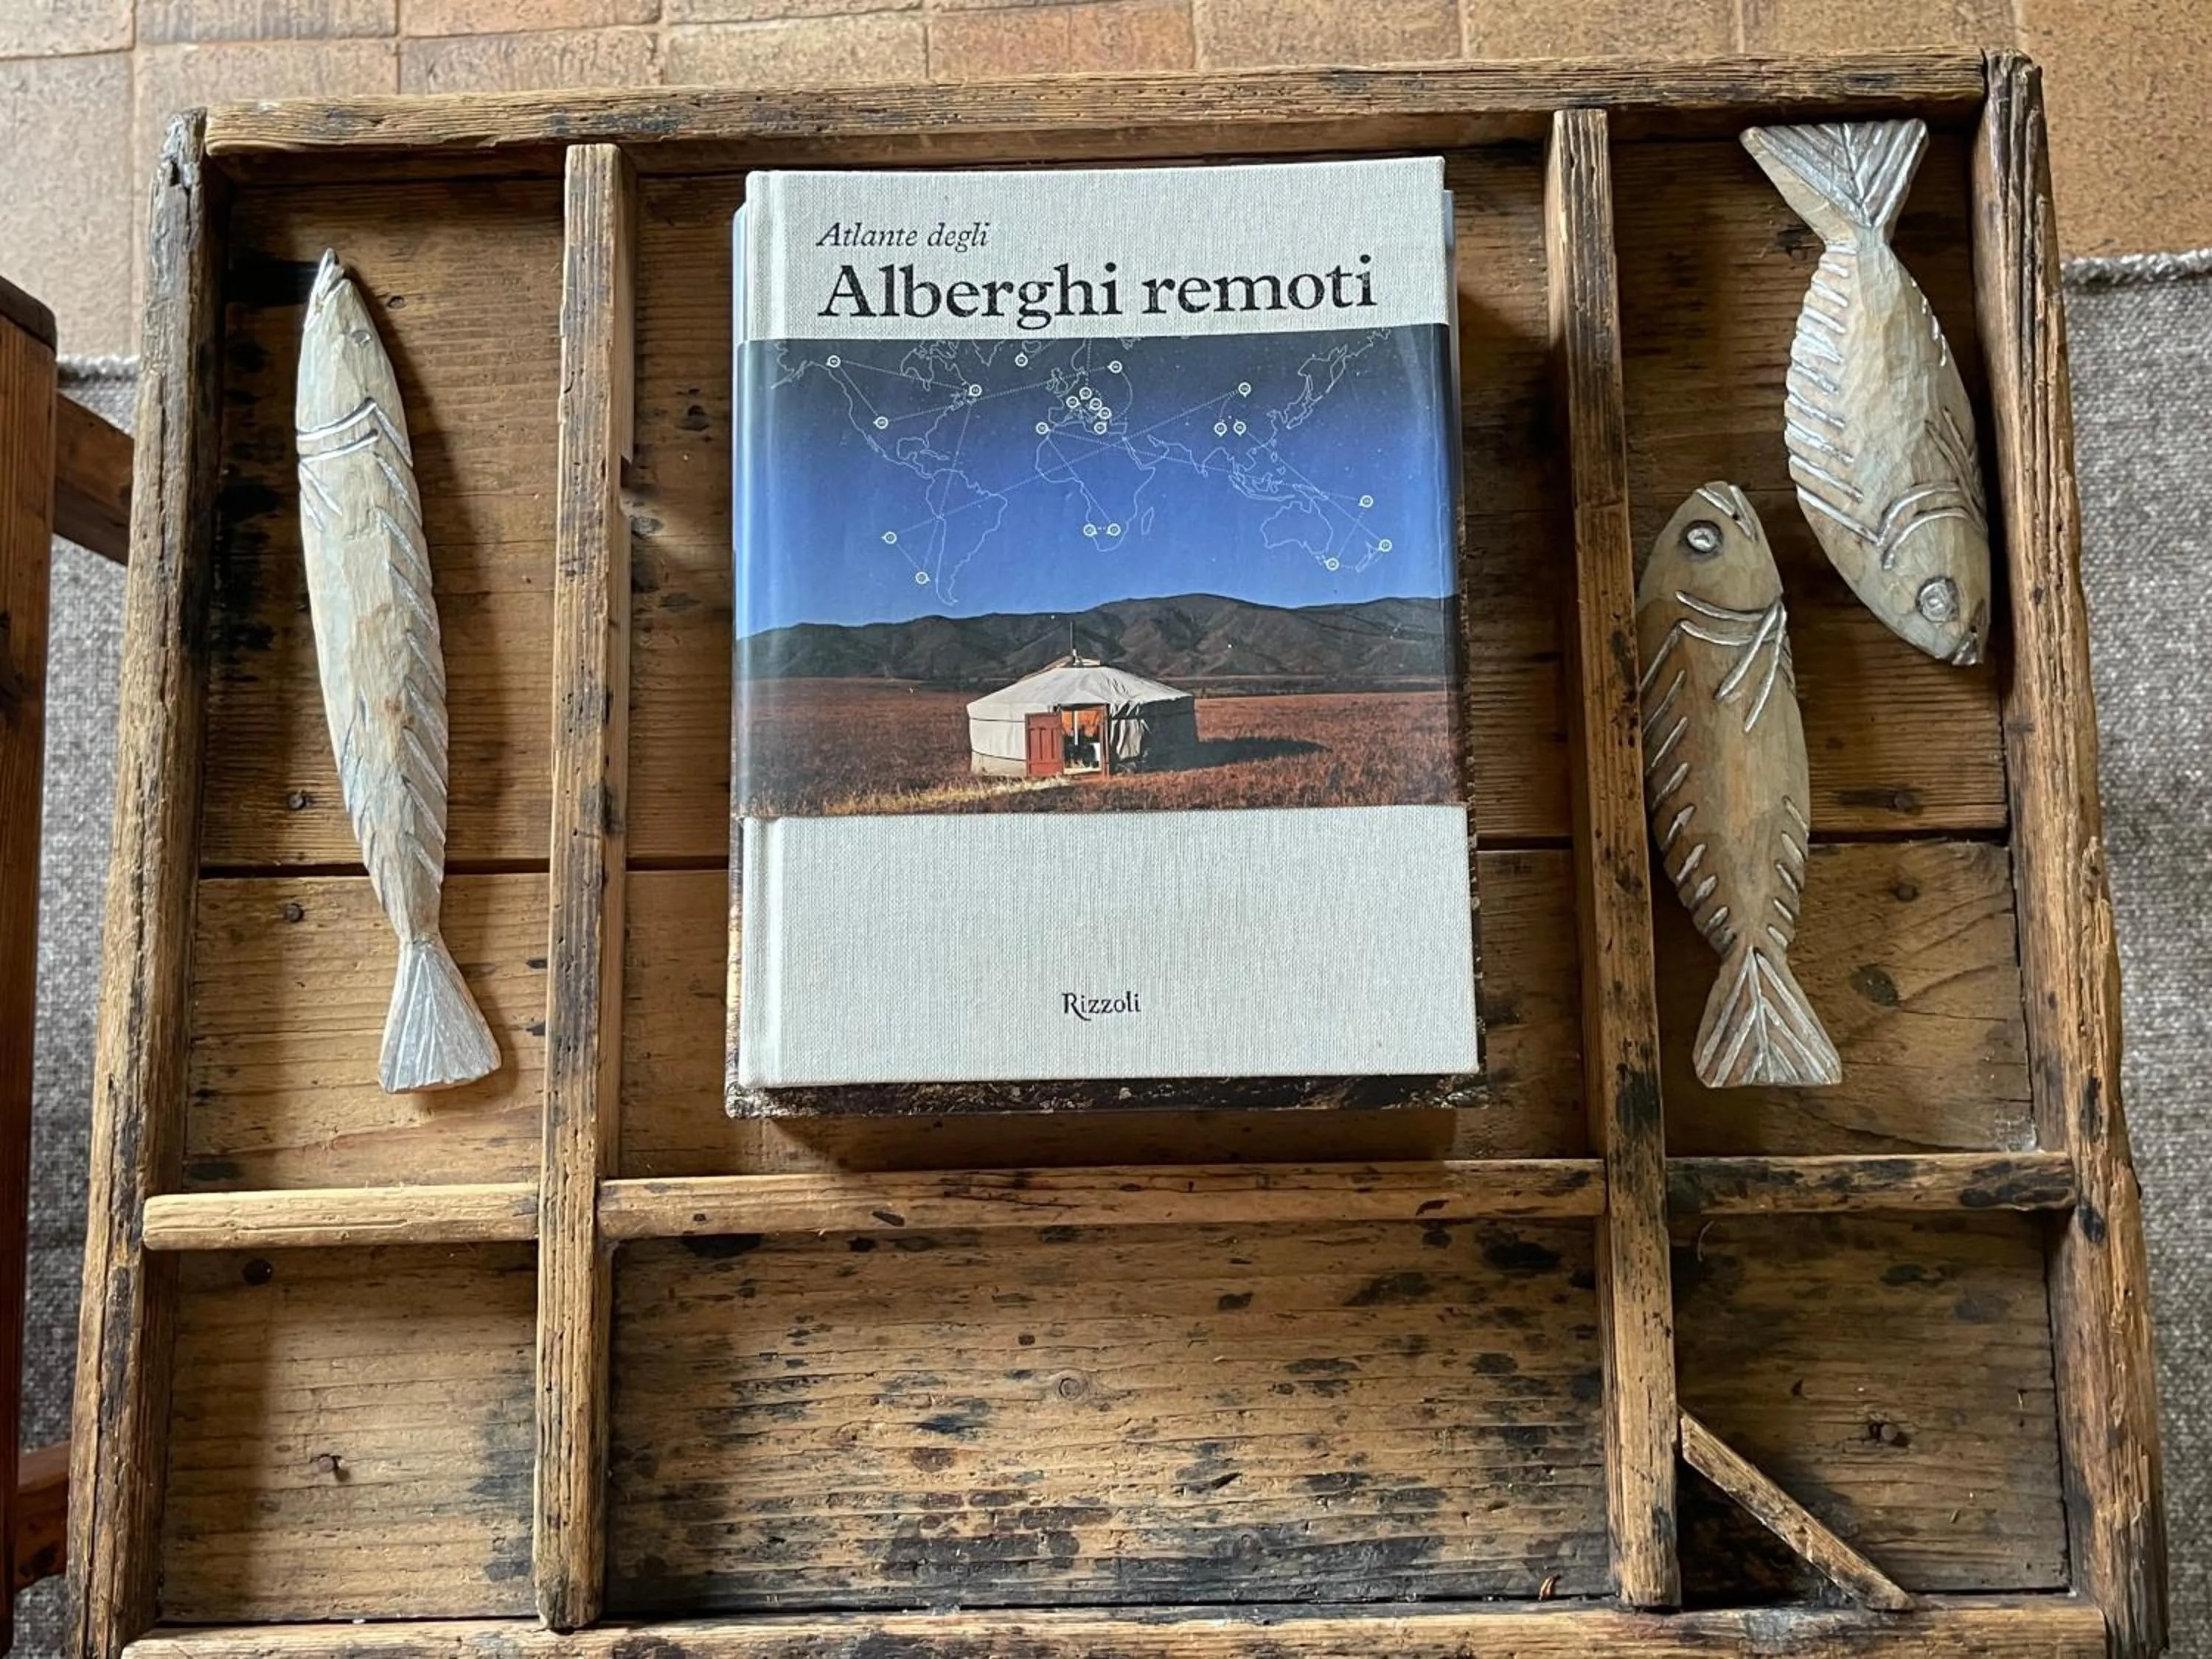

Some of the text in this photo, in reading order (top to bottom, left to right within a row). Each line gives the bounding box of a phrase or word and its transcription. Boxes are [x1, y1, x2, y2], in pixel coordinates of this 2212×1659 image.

[816, 222, 990, 254] Atlante degli
[817, 254, 1378, 330] Alberghi remoti
[1062, 991, 1140, 1021] Rizzoli
